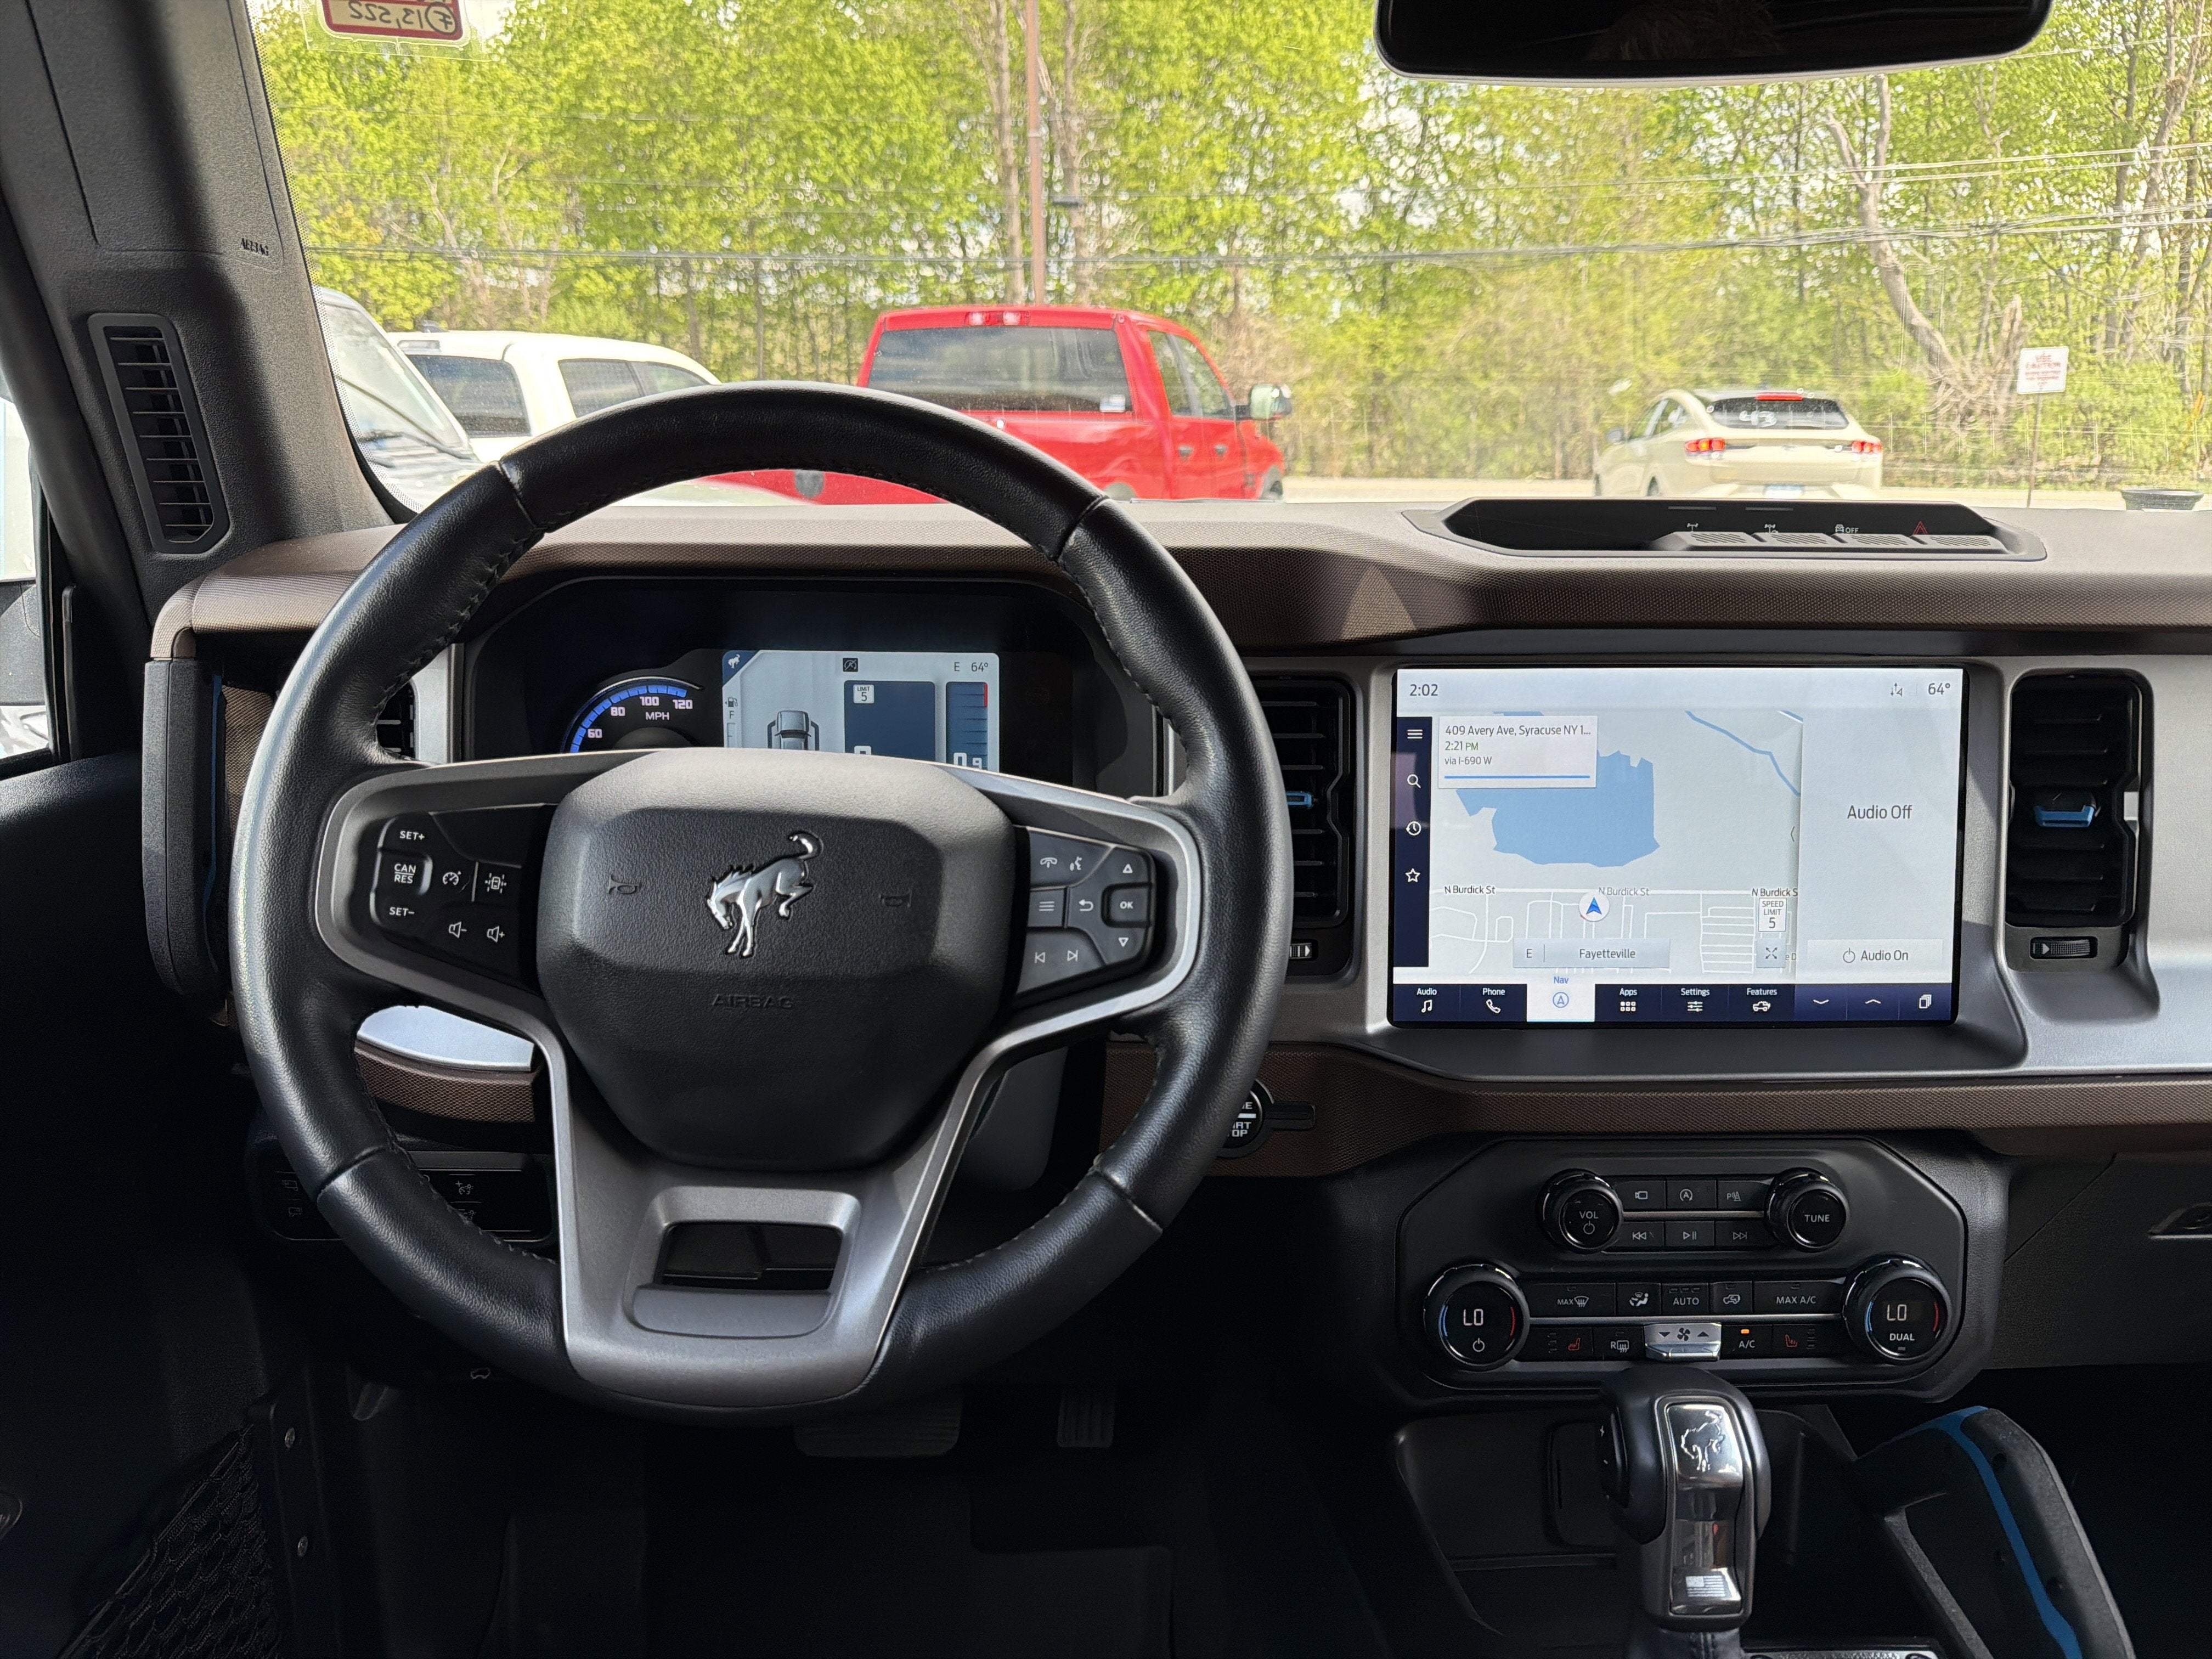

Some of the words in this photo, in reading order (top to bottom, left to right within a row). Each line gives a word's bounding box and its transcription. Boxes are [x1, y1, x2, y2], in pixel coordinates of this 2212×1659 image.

[954, 662, 960, 672] E
[1409, 684, 1438, 697] 2:02
[1927, 682, 1951, 696] 64°
[639, 696, 659, 706] 100
[861, 692, 867, 702] 5
[672, 699, 693, 709] 120
[611, 707, 625, 716] 80
[645, 712, 670, 720] MPH
[729, 710, 735, 719] F
[588, 729, 602, 738] 60
[1445, 725, 1465, 735] 409
[1468, 725, 1494, 737] Avery
[1497, 725, 1516, 737] Ave,
[1519, 725, 1561, 737] Syracuse
[1564, 725, 1577, 735] NY
[1444, 741, 1463, 751] 2:21
[1465, 742, 1479, 751] PM
[1444, 756, 1457, 765] via
[1458, 756, 1481, 765] I-690
[1483, 756, 1492, 765] W
[1847, 805, 1887, 819] Audio
[1891, 805, 1912, 819] Off
[399, 831, 425, 841] SET+
[394, 864, 416, 873] CAN
[394, 874, 413, 884] RES
[1444, 885, 1451, 894] N
[1453, 885, 1485, 895] Burdick
[1486, 885, 1496, 895] St
[1599, 887, 1605, 895] N
[1607, 887, 1638, 896] Burdick
[1640, 887, 1650, 896] St
[1752, 888, 1758, 896] N
[1760, 888, 1791, 896] Burdick
[1792, 888, 1798, 896] S
[1120, 901, 1134, 910] OK
[389, 906, 415, 916] SET-
[1769, 917, 1776, 929] 5
[1526, 949, 1532, 958] E
[1579, 949, 1636, 960] Fayetteville
[1860, 950, 1892, 962] Audio
[1893, 950, 1909, 962] On
[1554, 976, 1569, 985] Nav
[1417, 988, 1437, 996] Audio
[1482, 988, 1505, 996] Phone
[1619, 988, 1638, 997] Apps
[1680, 988, 1710, 997] Settings
[1746, 988, 1778, 996] Features
[712, 993, 793, 1008] AIRBAG
[1579, 1211, 1599, 1220] VOL
[1804, 1214, 1830, 1223] TUNE
[1673, 1297, 1700, 1306] AUTO
[1776, 1296, 1797, 1305] MAX
[1799, 1295, 1817, 1305] A/C
[1889, 1333, 1915, 1342] DUAL
[1738, 1340, 1756, 1349] A/C
